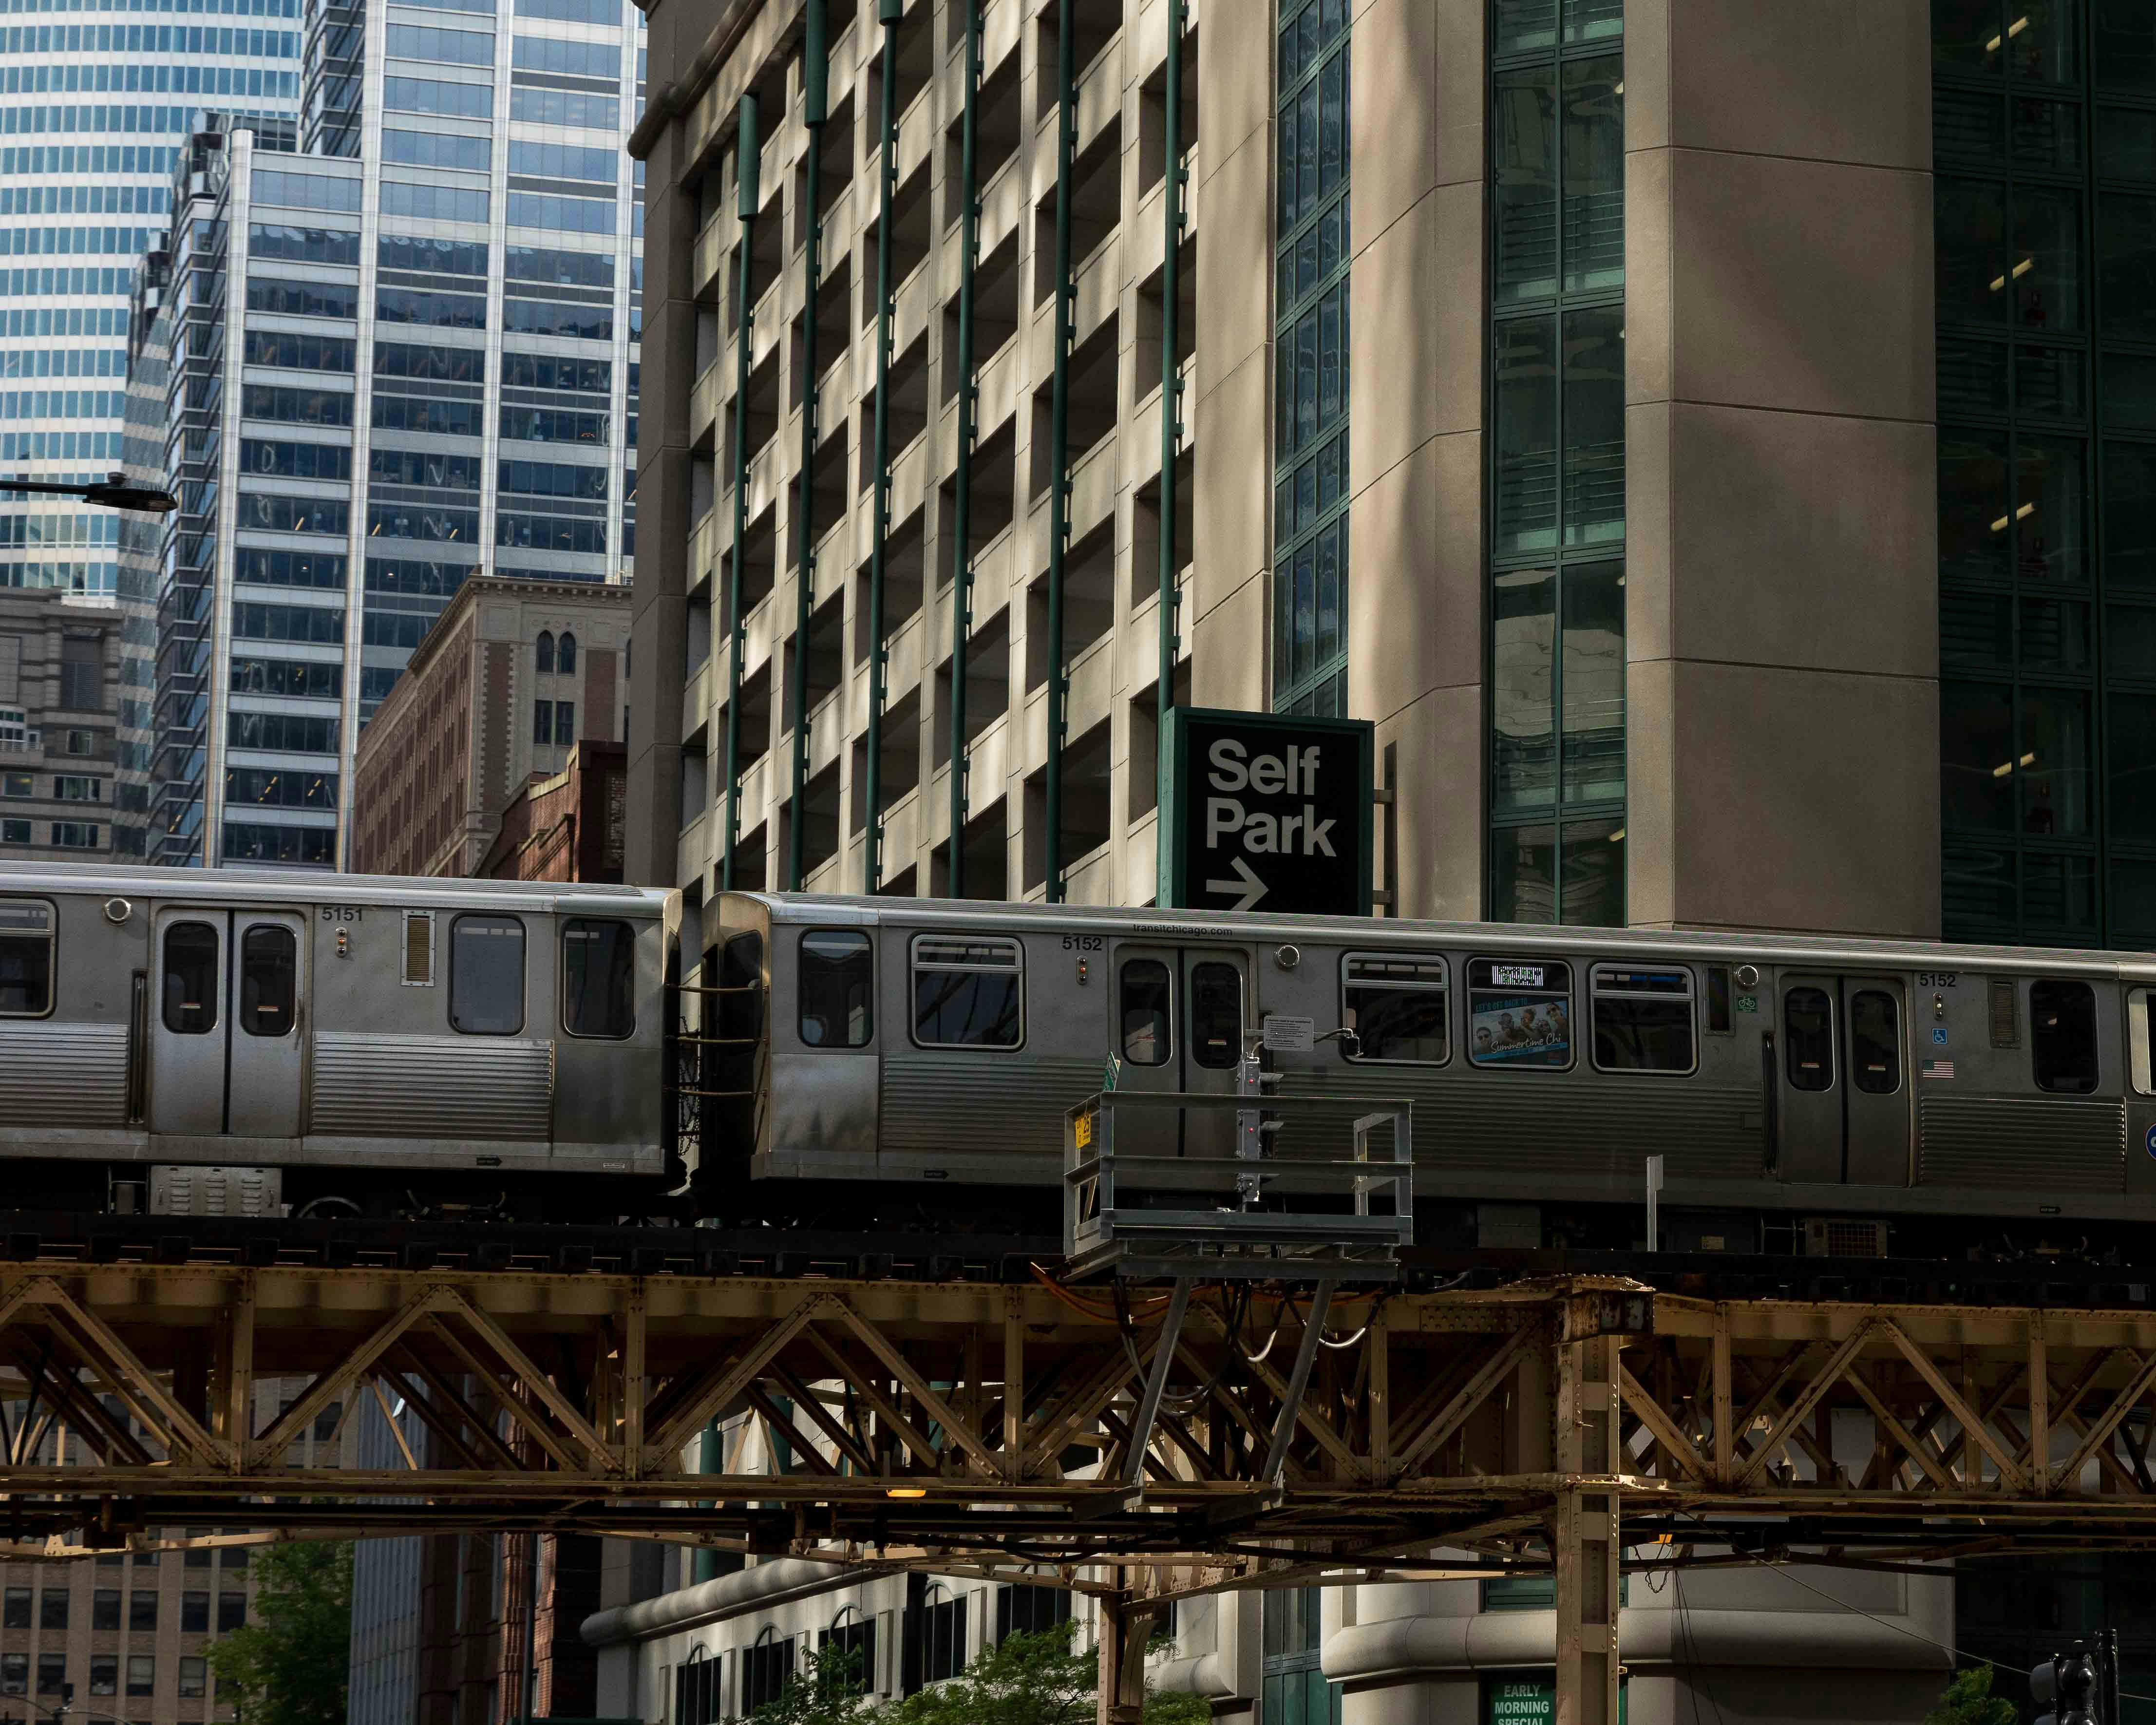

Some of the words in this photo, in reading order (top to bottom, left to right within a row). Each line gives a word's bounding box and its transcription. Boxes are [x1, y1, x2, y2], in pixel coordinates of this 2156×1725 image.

[1208, 739, 1320, 795] Self
[1207, 797, 1337, 857] Park
[322, 907, 362, 921] 5151
[1134, 924, 1232, 936] transitchicago.com
[1062, 936, 1102, 950] 5152
[1919, 974, 1956, 987] 5152
[1520, 998, 1528, 1006] TO
[1491, 1037, 1544, 1053] Summertime
[1546, 1032, 1561, 1045] Chi
[1083, 1116, 1090, 1133] 25
[1504, 1685, 1541, 1697] EARLY
[1495, 1701, 1549, 1714] MORNING
